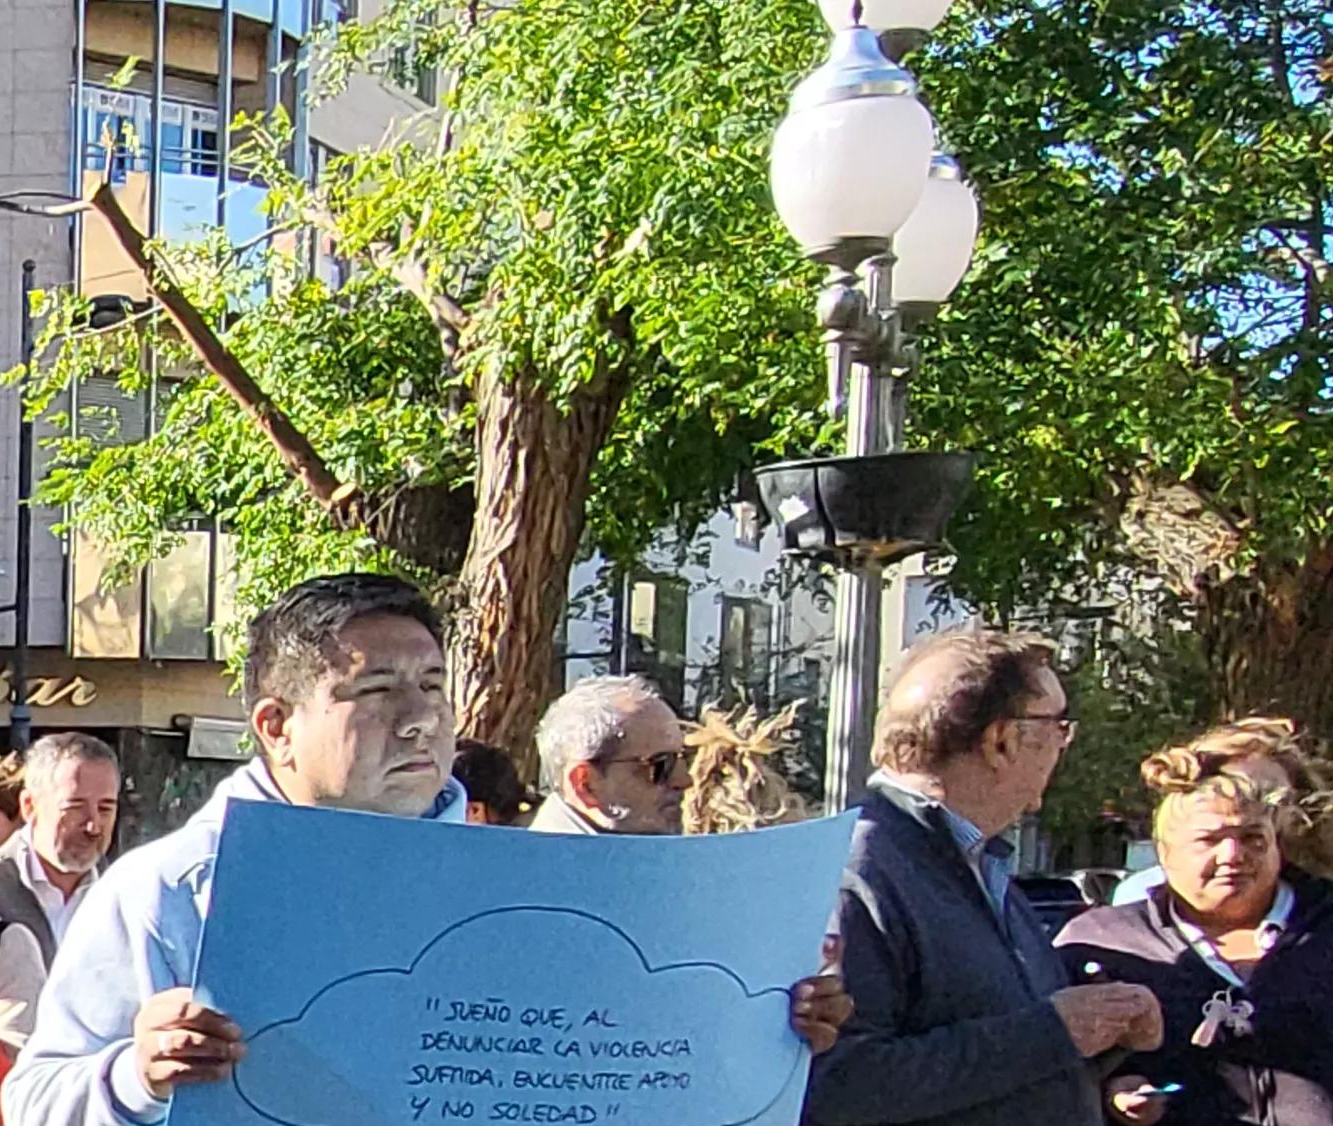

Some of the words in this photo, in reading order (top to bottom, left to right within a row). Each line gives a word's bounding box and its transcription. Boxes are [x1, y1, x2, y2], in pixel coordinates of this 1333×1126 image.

[519, 1006, 573, 1033] QUE,
[582, 1008, 619, 1027] AL
[420, 1030, 544, 1056] DENUNCIAR
[553, 1038, 581, 1057] LA
[588, 1037, 693, 1059] VIOLENCIA
[441, 1100, 475, 1119] NO
